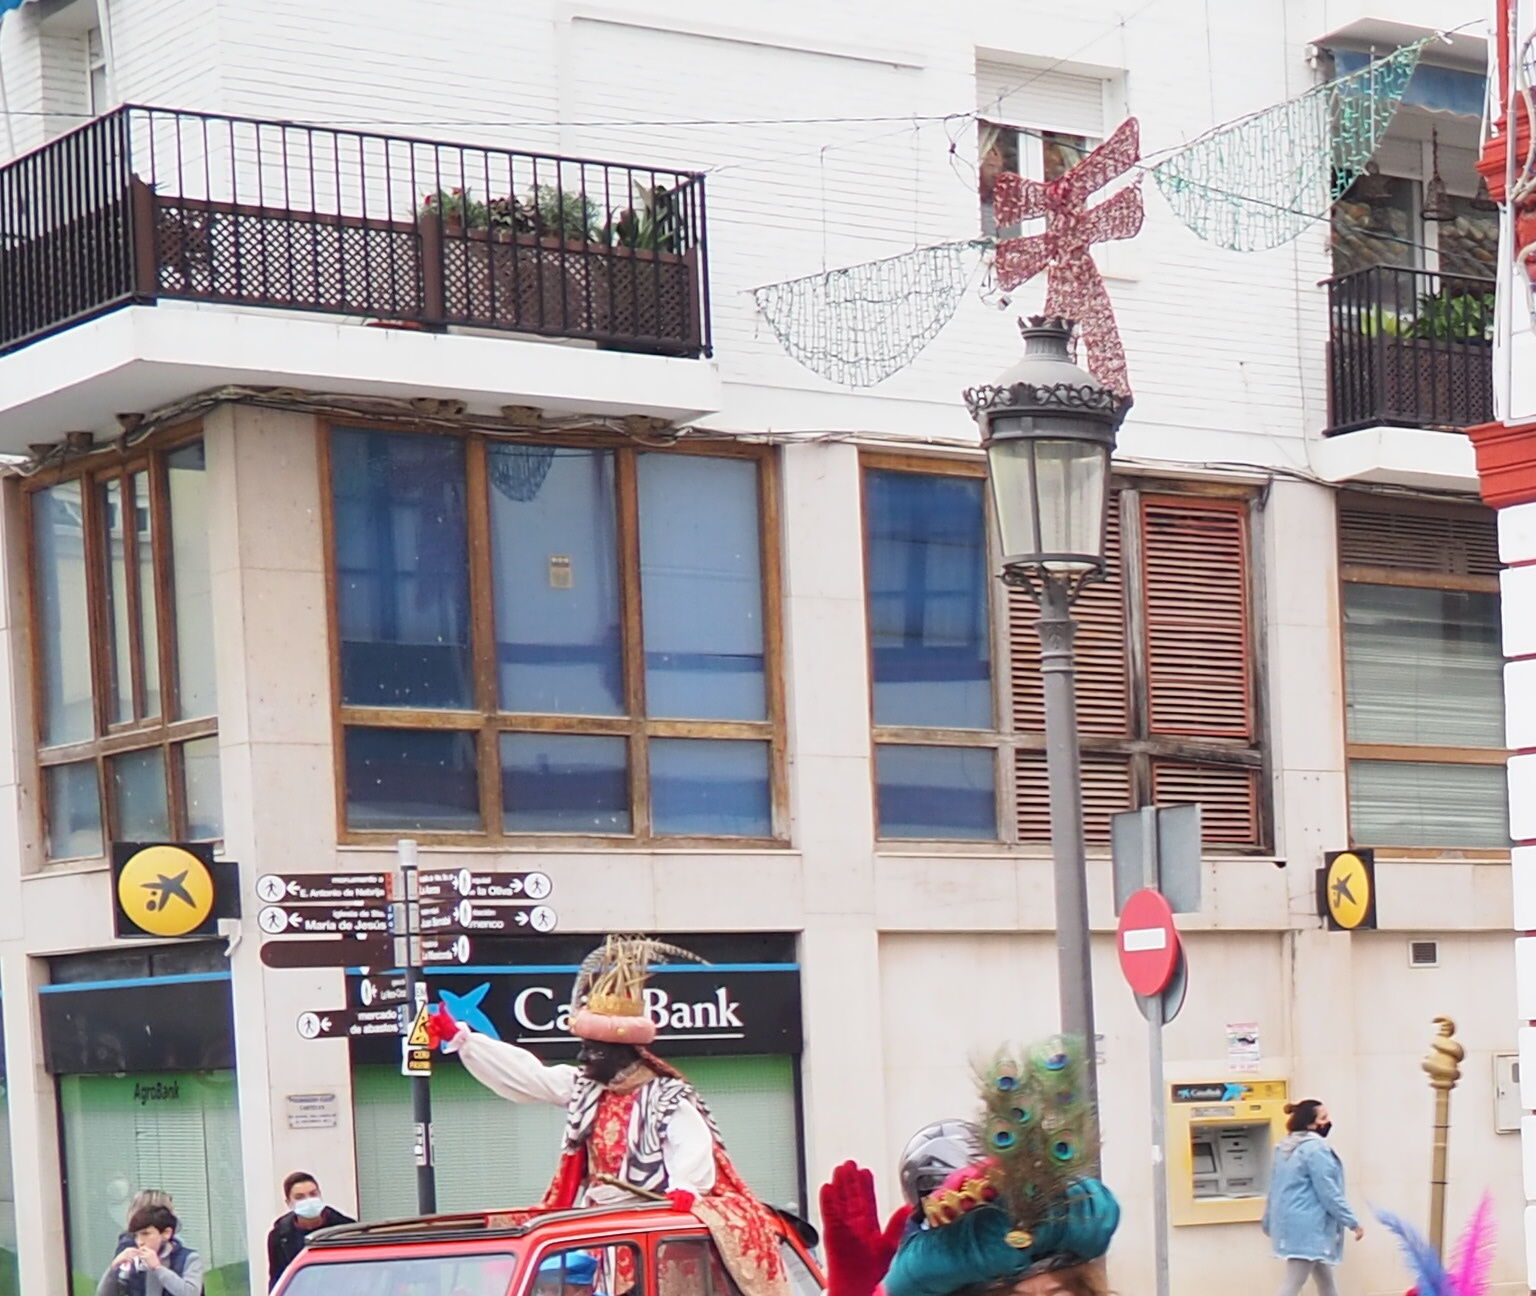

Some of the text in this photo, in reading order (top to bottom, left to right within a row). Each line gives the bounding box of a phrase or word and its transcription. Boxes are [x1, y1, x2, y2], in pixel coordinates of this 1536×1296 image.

[309, 889, 343, 898] Antonio
[343, 889, 354, 897] de
[355, 888, 385, 898] Nebrija
[488, 886, 514, 896] Oliva
[305, 920, 387, 931] María de Jesús
[514, 986, 745, 1032] CaBank
[357, 1009, 398, 1021] mercado
[349, 1023, 399, 1034] de abastos
[133, 1081, 180, 1105] AgroBank
